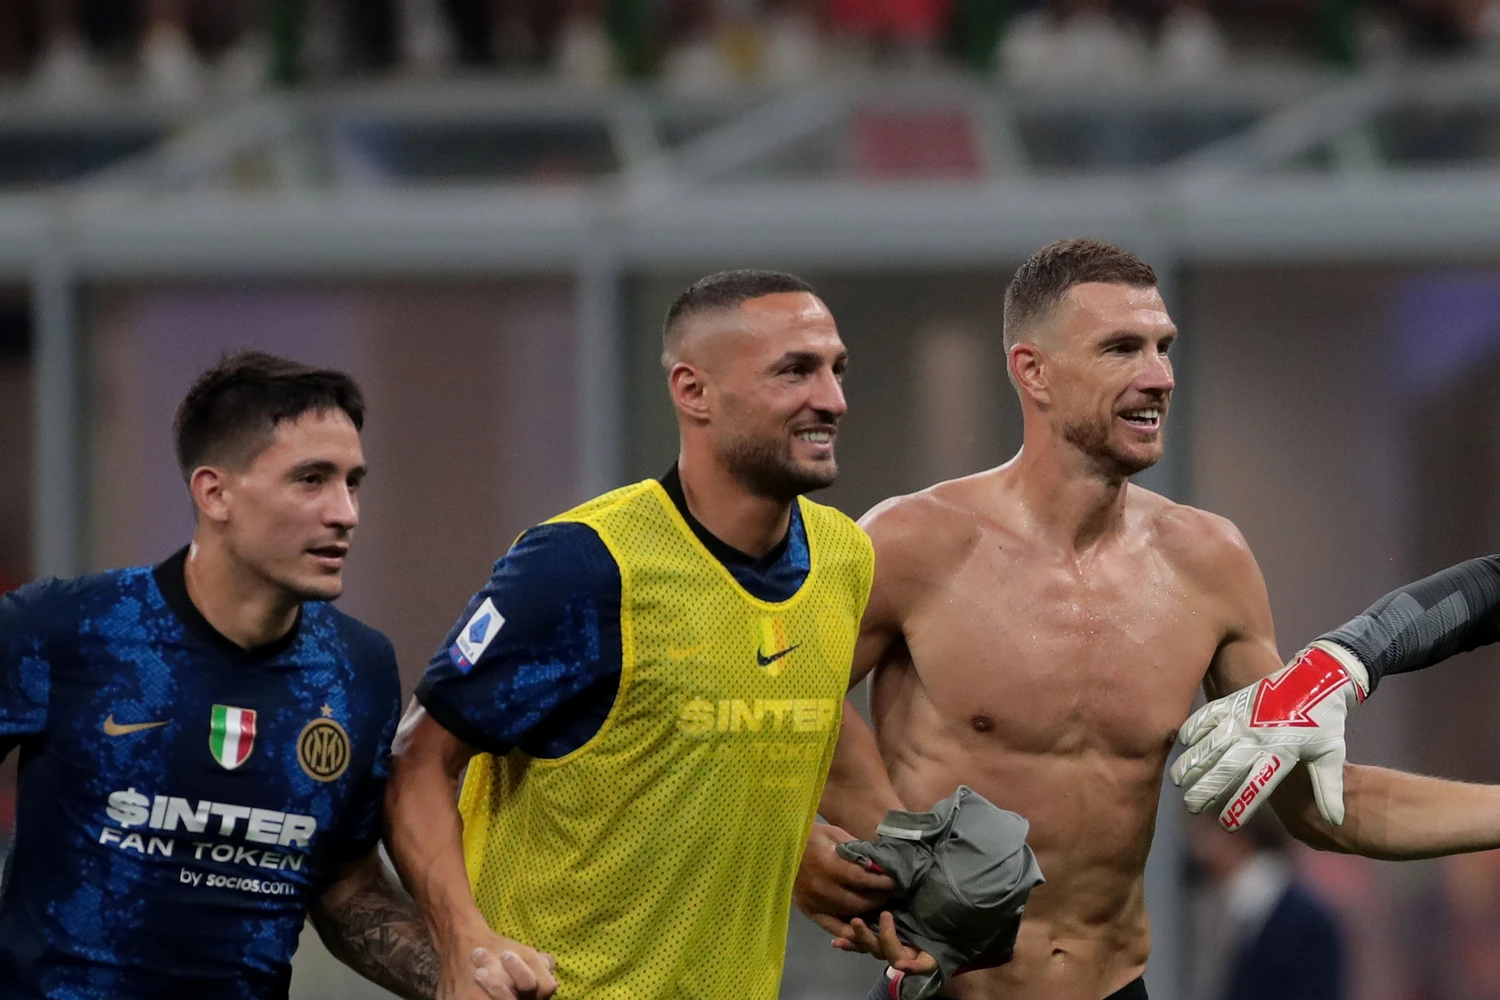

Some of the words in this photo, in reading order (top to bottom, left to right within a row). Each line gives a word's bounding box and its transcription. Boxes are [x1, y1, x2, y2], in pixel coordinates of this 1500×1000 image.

[106, 787, 317, 848] $INTER
[1221, 755, 1281, 829] reusch
[99, 827, 174, 857] FAN
[193, 842, 304, 872] TOKEN
[180, 868, 202, 887] by
